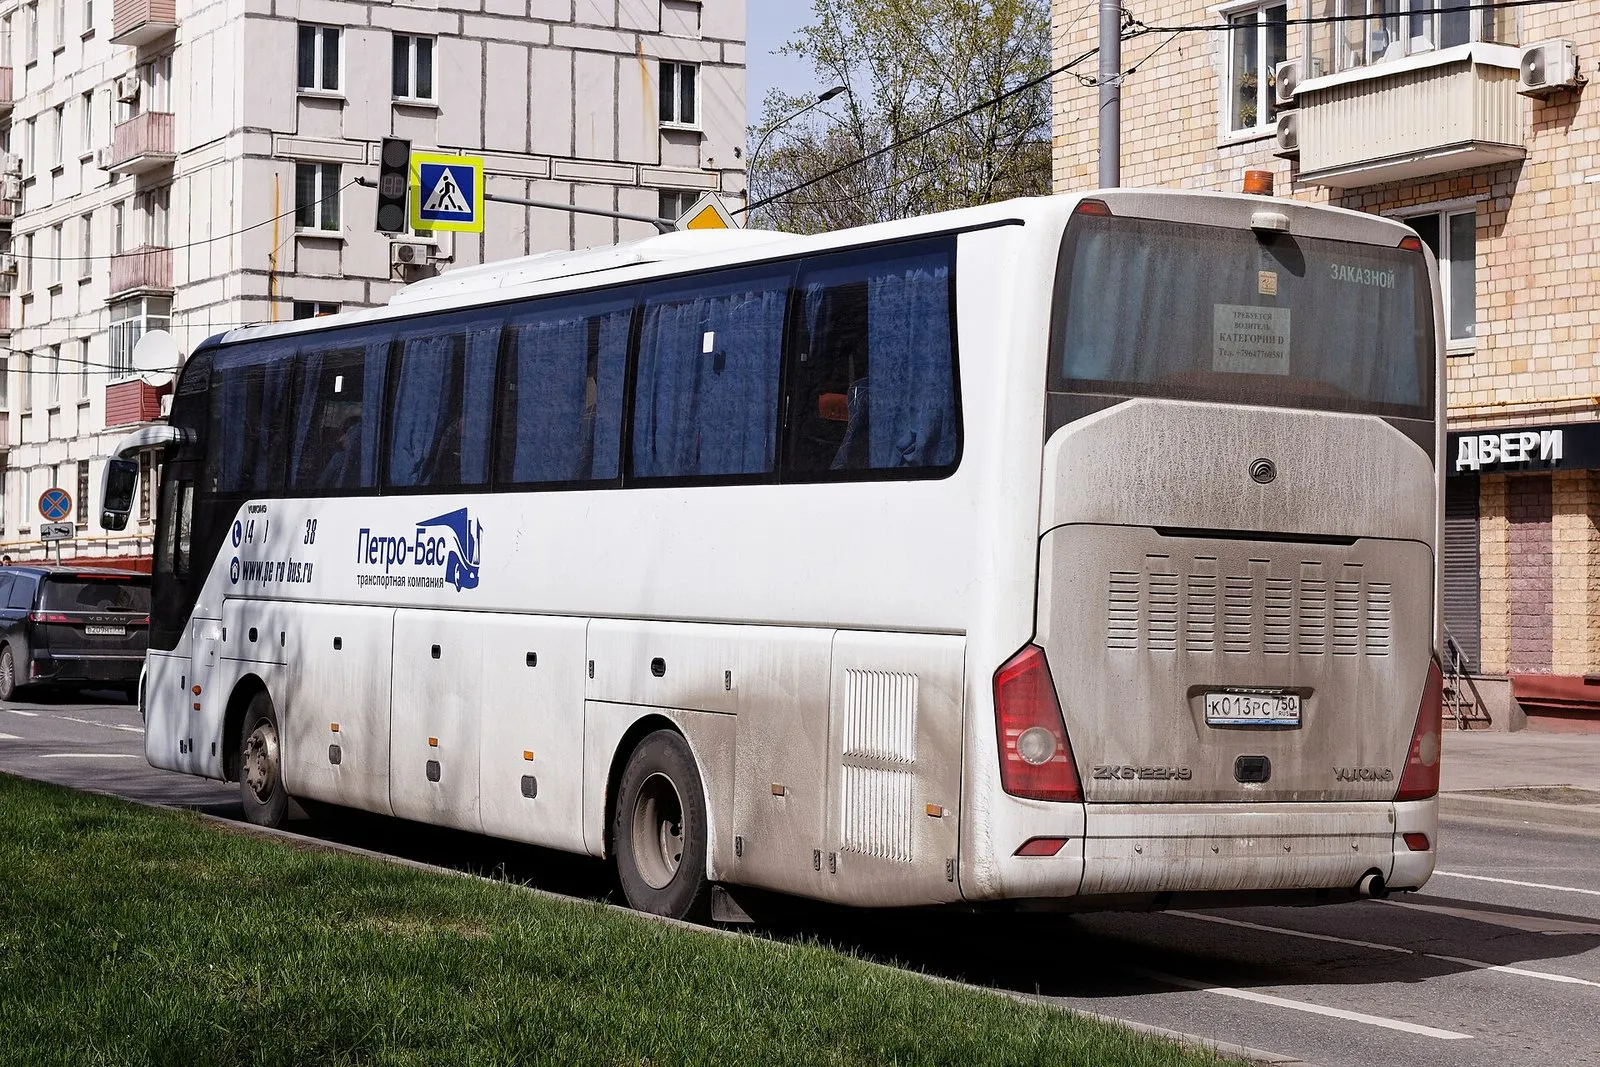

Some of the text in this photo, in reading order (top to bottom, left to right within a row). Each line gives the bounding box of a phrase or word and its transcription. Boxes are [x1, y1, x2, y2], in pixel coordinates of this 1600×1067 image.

[1330, 263, 1395, 289] ЗАКАЗНОЙ
[1233, 311, 1272, 320] ТРЕБУЕТСЯ
[1234, 322, 1271, 331] ВОДИТЕЛЬ
[1219, 332, 1275, 344] КАТЕГОРИИ
[1456, 429, 1563, 472] ДВЕРИ
[357, 528, 446, 574] Петро-Бас
[357, 574, 444, 590] транспортная компания
[1093, 765, 1193, 780] ZK6122H9
[1332, 767, 1394, 782] YUTONG
